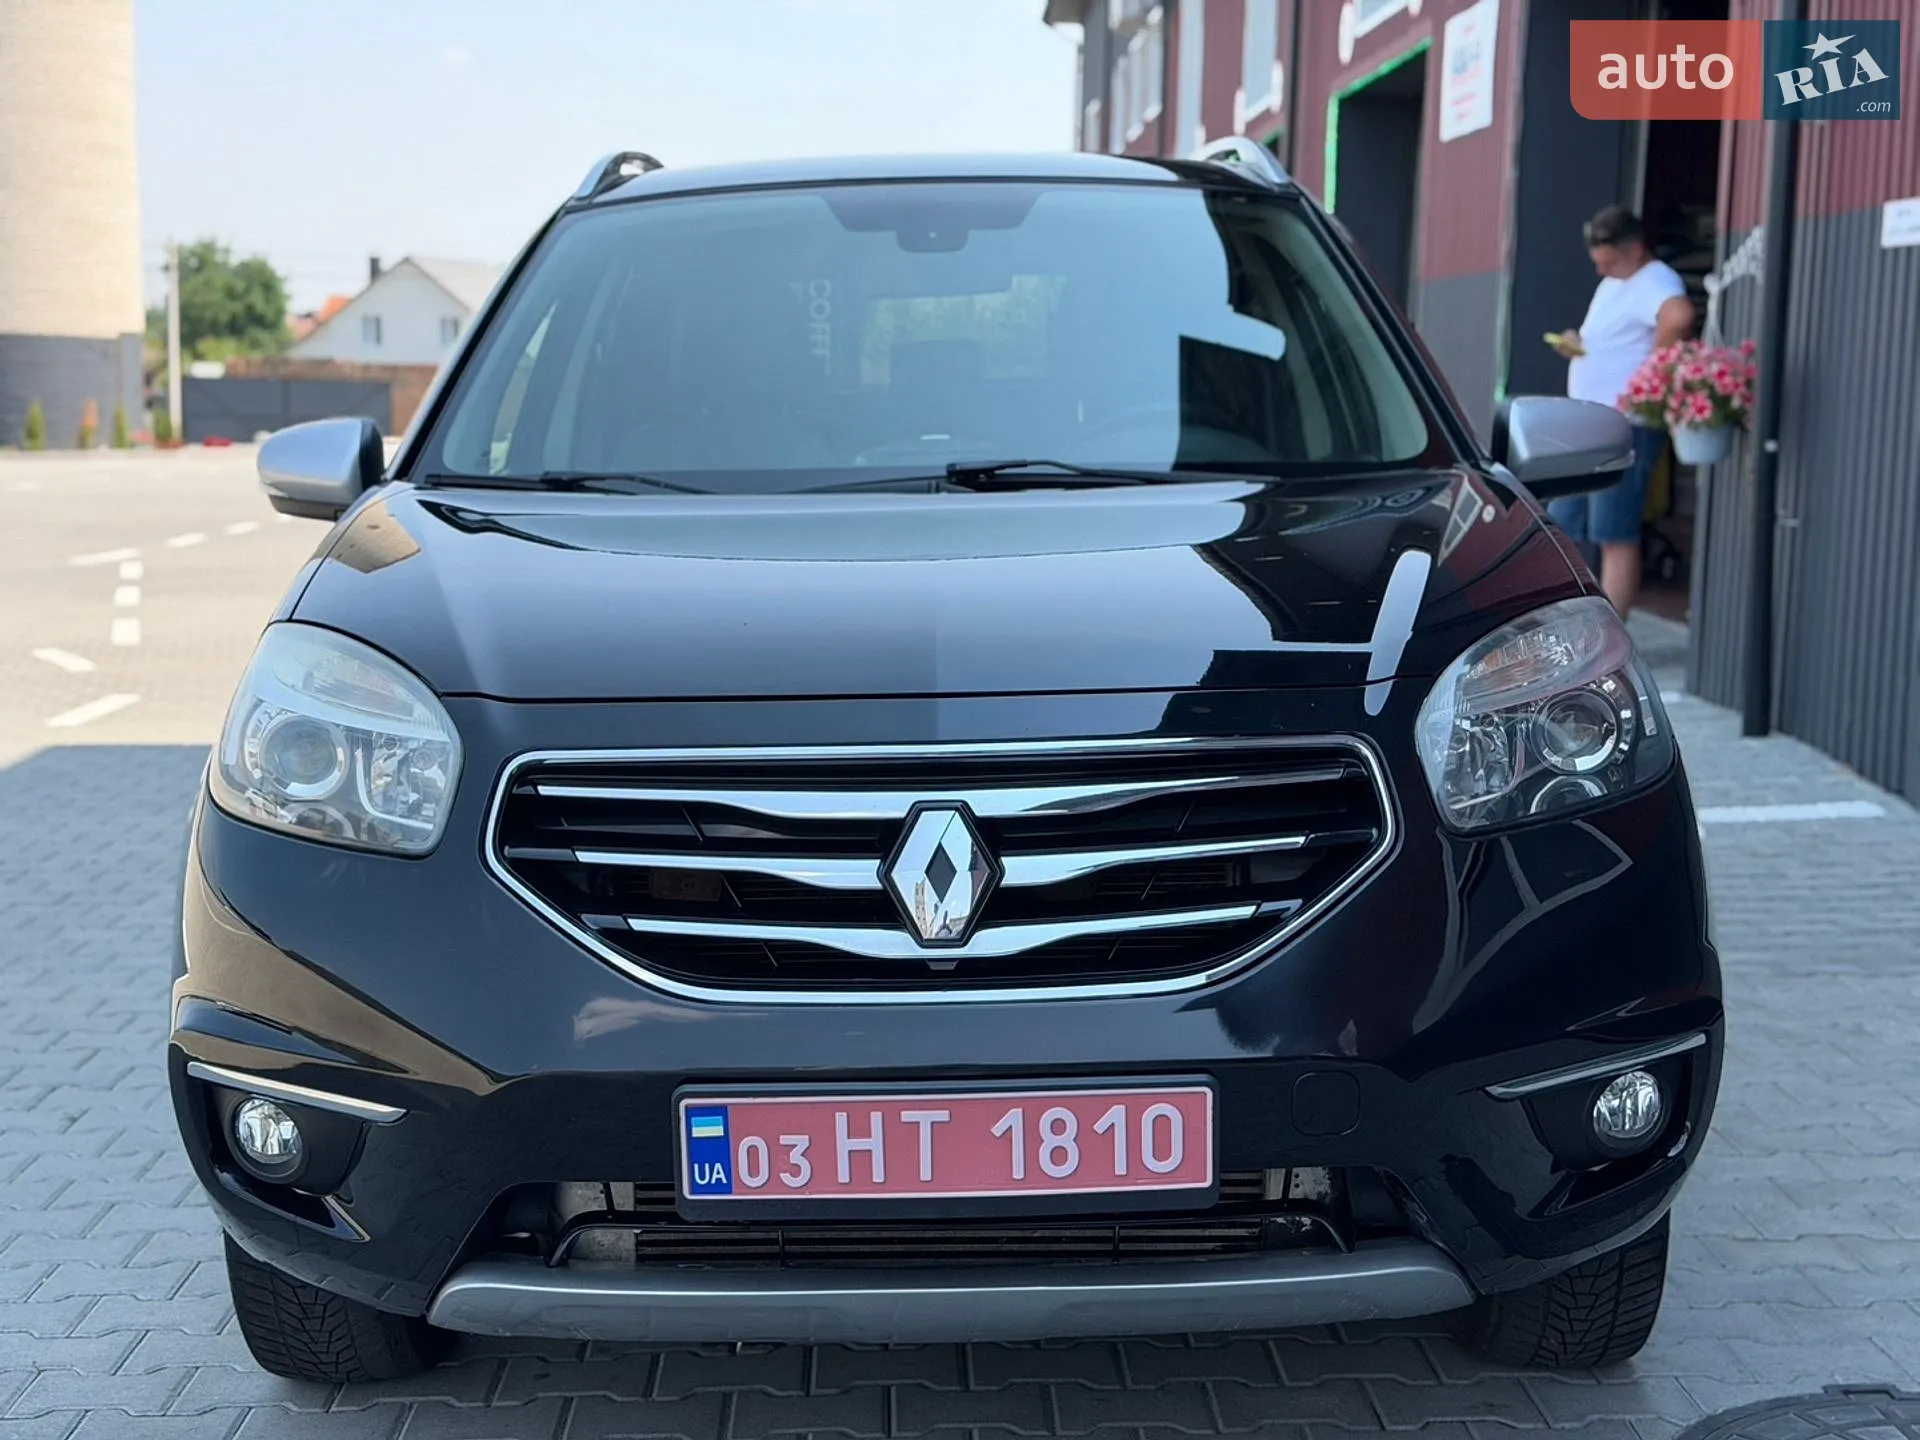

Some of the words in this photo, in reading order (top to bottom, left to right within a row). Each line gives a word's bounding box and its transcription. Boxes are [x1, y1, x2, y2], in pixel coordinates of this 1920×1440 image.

[809, 279, 831, 376] COFF
[693, 1162, 728, 1186] UA
[737, 1133, 813, 1189] 03
[834, 1108, 951, 1185] HT
[989, 1102, 1185, 1180] 1810
